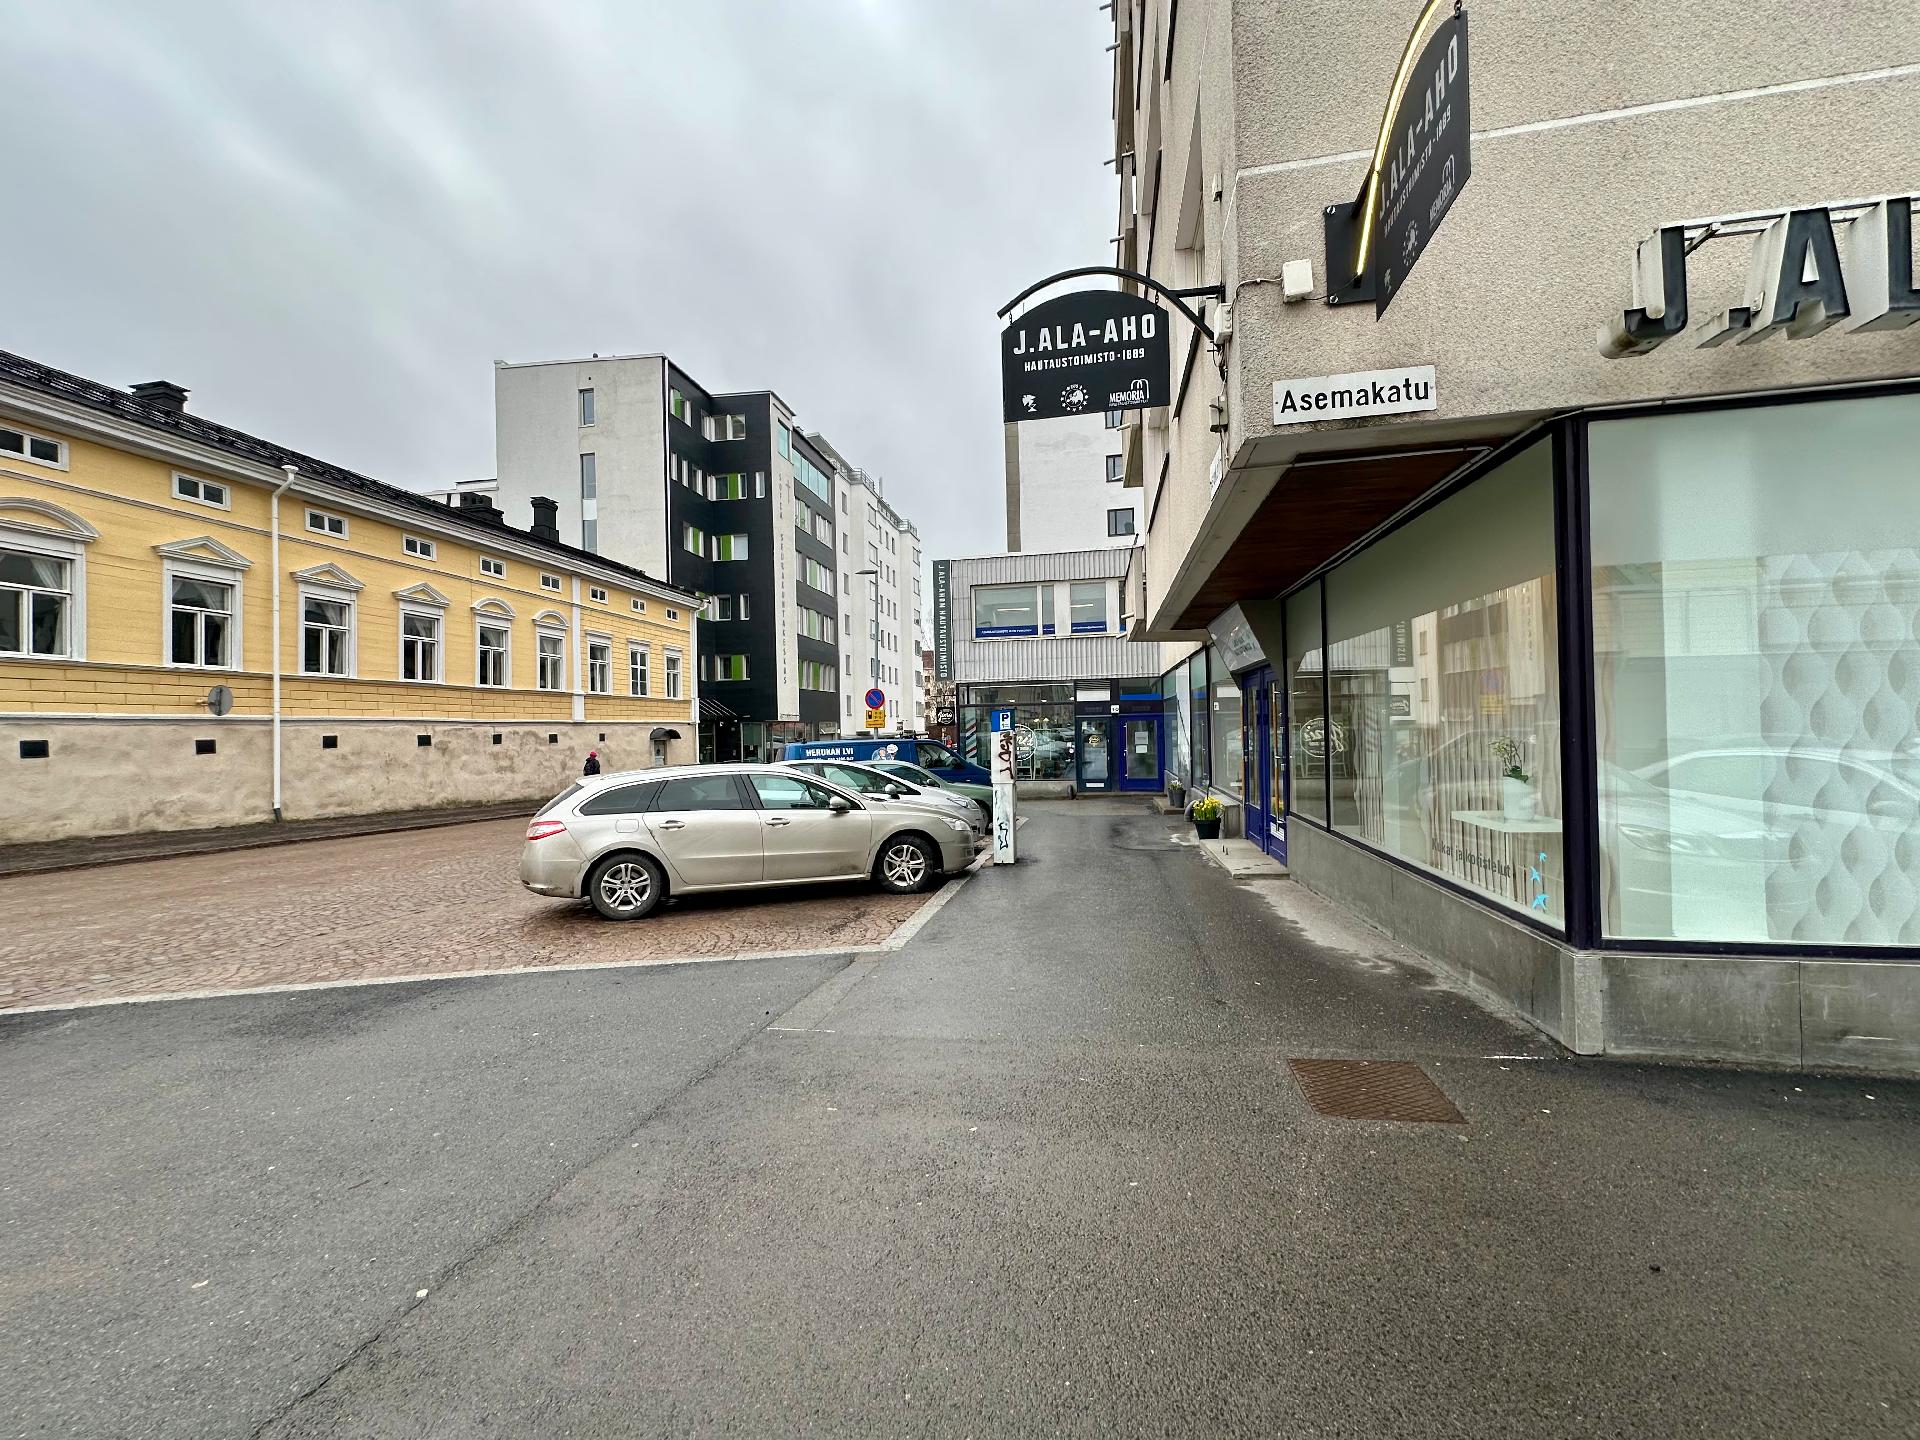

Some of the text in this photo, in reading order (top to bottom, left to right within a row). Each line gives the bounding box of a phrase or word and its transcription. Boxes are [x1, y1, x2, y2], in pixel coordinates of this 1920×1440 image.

[1379, 34, 1458, 221] J.ALA-AHO
[1013, 313, 1156, 355] J.ALA-AHO
[1024, 351, 1115, 372] HAUTAUSTOIMISTO
[1109, 389, 1145, 403] MEMORIA
[1280, 377, 1429, 414] Asemakatu
[1002, 713, 1009, 721] P
